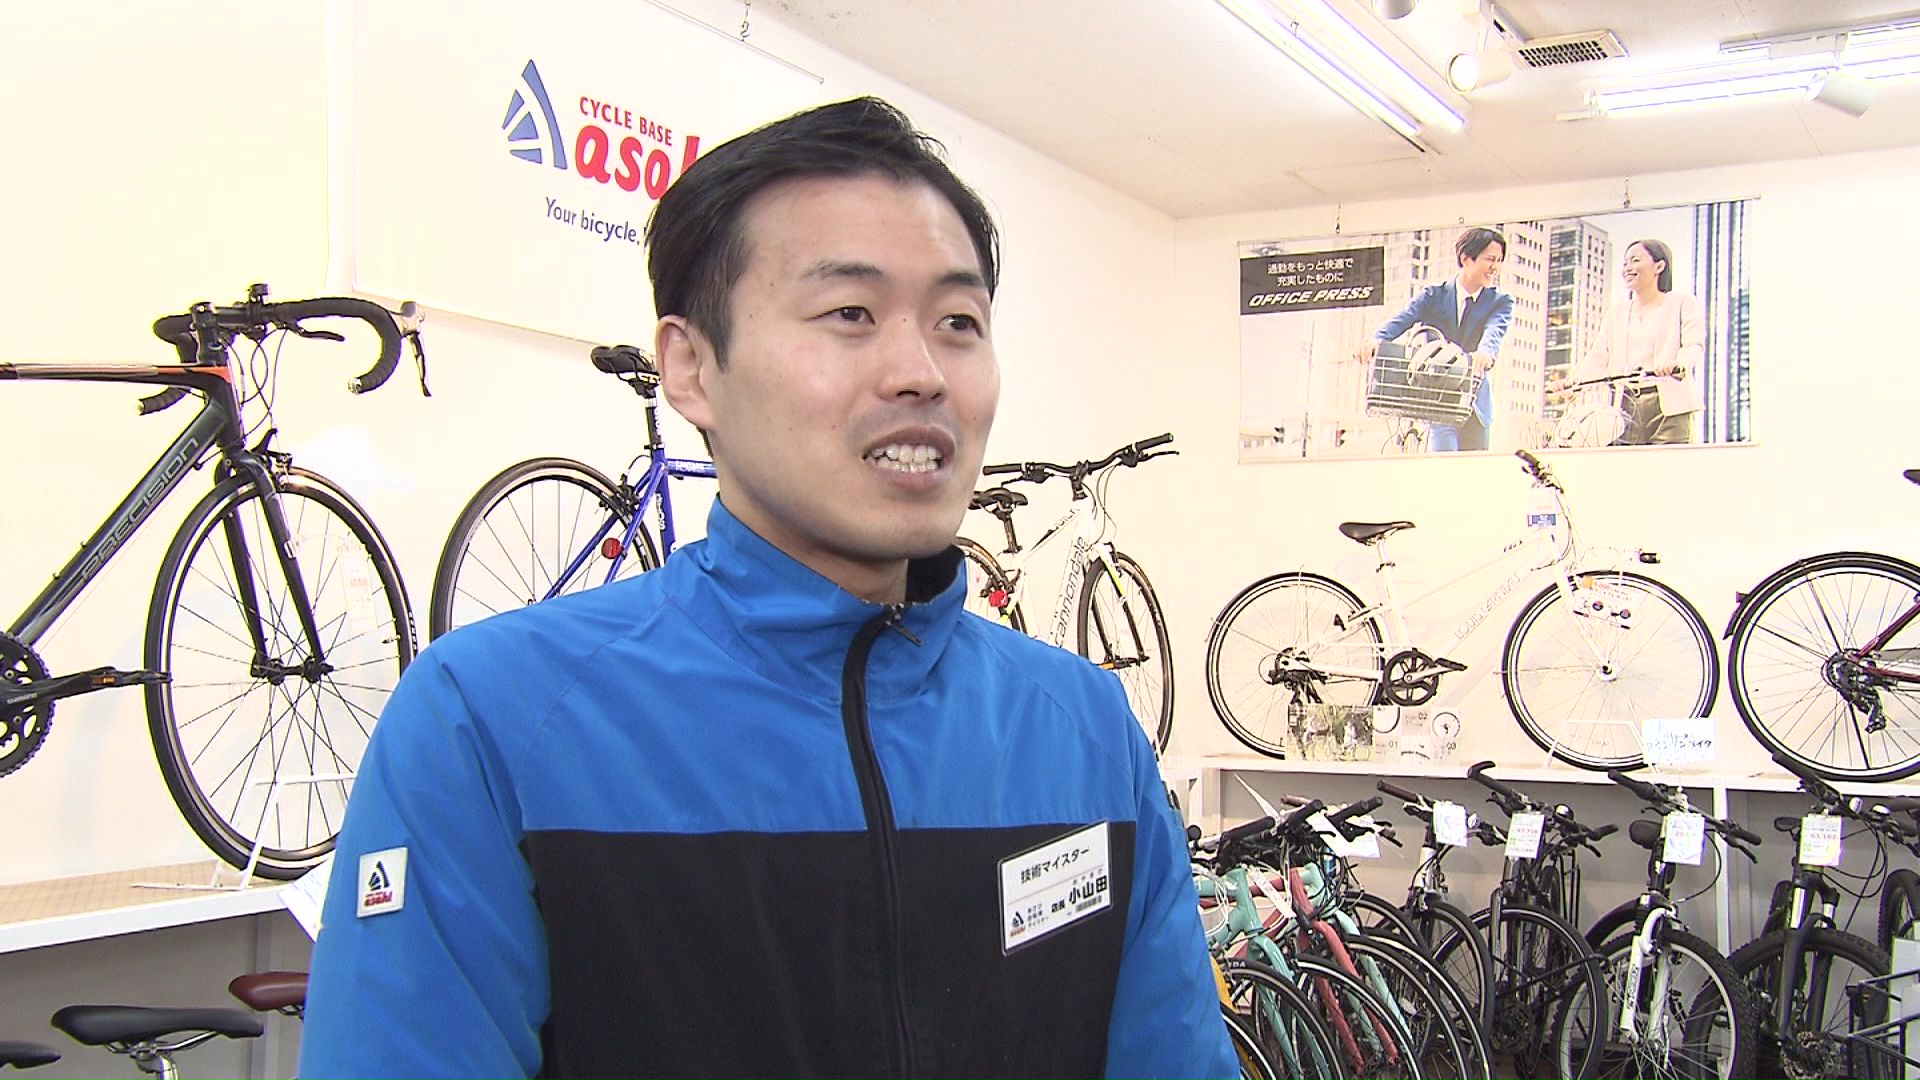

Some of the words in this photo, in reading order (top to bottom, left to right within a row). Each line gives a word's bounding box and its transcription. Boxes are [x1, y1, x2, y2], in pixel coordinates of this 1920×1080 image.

[579, 96, 632, 130] CYCLE
[639, 116, 673, 147] BASE
[545, 197, 577, 226] Your
[581, 210, 640, 246] bicycle.
[1277, 272, 1344, 287] 充実したものに
[1248, 291, 1312, 307] OFFICE
[1313, 286, 1373, 303] PRESS
[1020, 848, 1090, 884] 技術マイスター
[1069, 875, 1107, 905] 小山田
